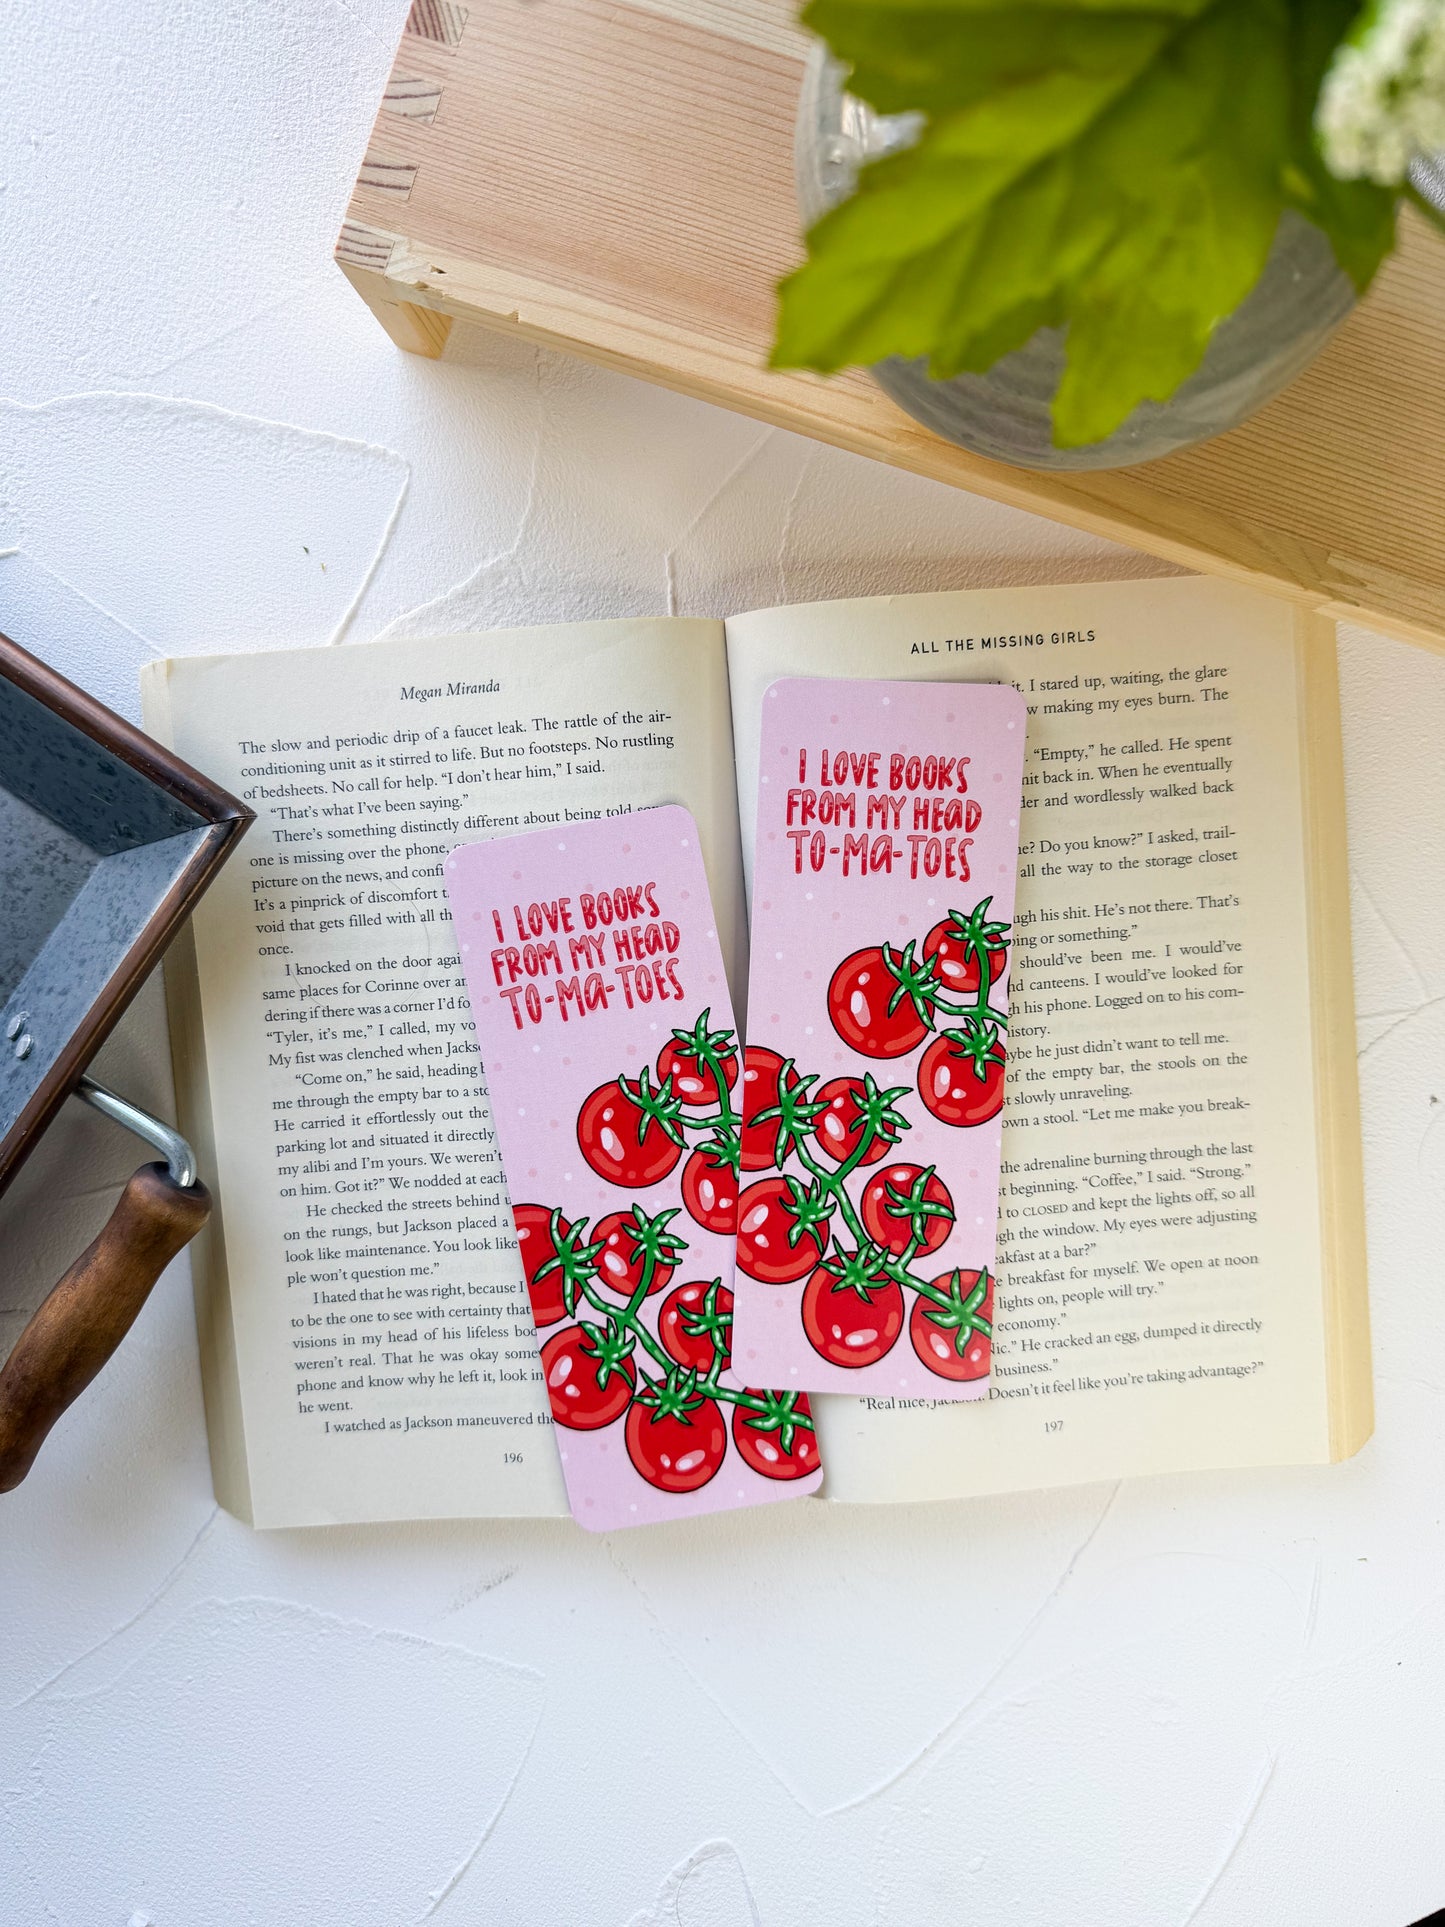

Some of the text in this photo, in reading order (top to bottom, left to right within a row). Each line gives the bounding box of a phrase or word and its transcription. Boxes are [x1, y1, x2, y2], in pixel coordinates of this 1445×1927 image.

[910, 630, 1096, 655] ALL THE MISSING GIRLS
[400, 678, 500, 703] Megan Miranda
[1029, 665, 1228, 692] I stared up, waiting, the glare
[1042, 687, 1230, 715] making my eyes burn. The
[238, 709, 672, 754] The slow and periodic drip of a faucet leak. The rattle of the air-
[240, 732, 675, 777] conditioning unit as it stirred to life. But no footsteps. No rustling
[1099, 743, 1117, 756] he
[1120, 738, 1164, 755] called.
[1168, 737, 1192, 751] He
[1194, 736, 1232, 752] spent
[242, 785, 260, 800] of
[259, 783, 328, 799] bedsheets.
[330, 780, 355, 794] No
[357, 777, 380, 792] call
[382, 776, 403, 790] for
[405, 773, 438, 791] help.
[493, 767, 523, 781] hear
[566, 762, 572, 775] I
[575, 759, 606, 775] said.
[799, 748, 971, 793] I LOVE BOOKS
[320, 803, 355, 817] what
[384, 799, 417, 813] been
[786, 789, 856, 828] FROM
[867, 794, 906, 830] MY
[326, 823, 398, 839] something
[400, 817, 460, 834] distinctly
[463, 814, 520, 829] different
[523, 811, 561, 825] about
[492, 881, 660, 943] I LOVE BOOKS
[1039, 908, 1060, 922] his
[1062, 906, 1092, 920] shit.
[1128, 904, 1152, 915] not
[1154, 899, 1193, 912] there.
[490, 940, 563, 986] FROM
[568, 932, 606, 971] MY
[1090, 950, 1124, 963] been
[1130, 949, 1157, 960] me.
[1164, 944, 1172, 957] I
[1035, 1045, 1052, 1058] he
[1052, 1043, 1080, 1061] just
[1124, 1039, 1159, 1050] want
[1160, 1038, 1176, 1048] to
[1178, 1032, 1201, 1046] tell
[1203, 1034, 1230, 1044] me.
[1014, 1084, 1133, 1106] slowly unraveling.
[274, 1106, 489, 1132] He carried it effortlessly out the
[278, 1165, 300, 1178] my
[302, 1159, 331, 1174] alibi
[334, 1157, 358, 1172] and
[386, 1157, 428, 1172] yours.
[428, 1152, 452, 1165] We
[999, 1141, 1254, 1174] the adrenaline burning through the last
[279, 1187, 298, 1197] on
[300, 1183, 332, 1196] him.
[334, 1180, 361, 1194] Got
[387, 1176, 411, 1189] We
[413, 1172, 462, 1188] nodded
[464, 1175, 478, 1185] at
[479, 1170, 508, 1185] each
[1006, 1255, 1259, 1286] breakfast for myself. We open at noon
[313, 1280, 524, 1305] I hated that he was right, because I
[298, 1401, 354, 1414] he went.
[1044, 1420, 1064, 1433] 197
[503, 1452, 524, 1464] 196
